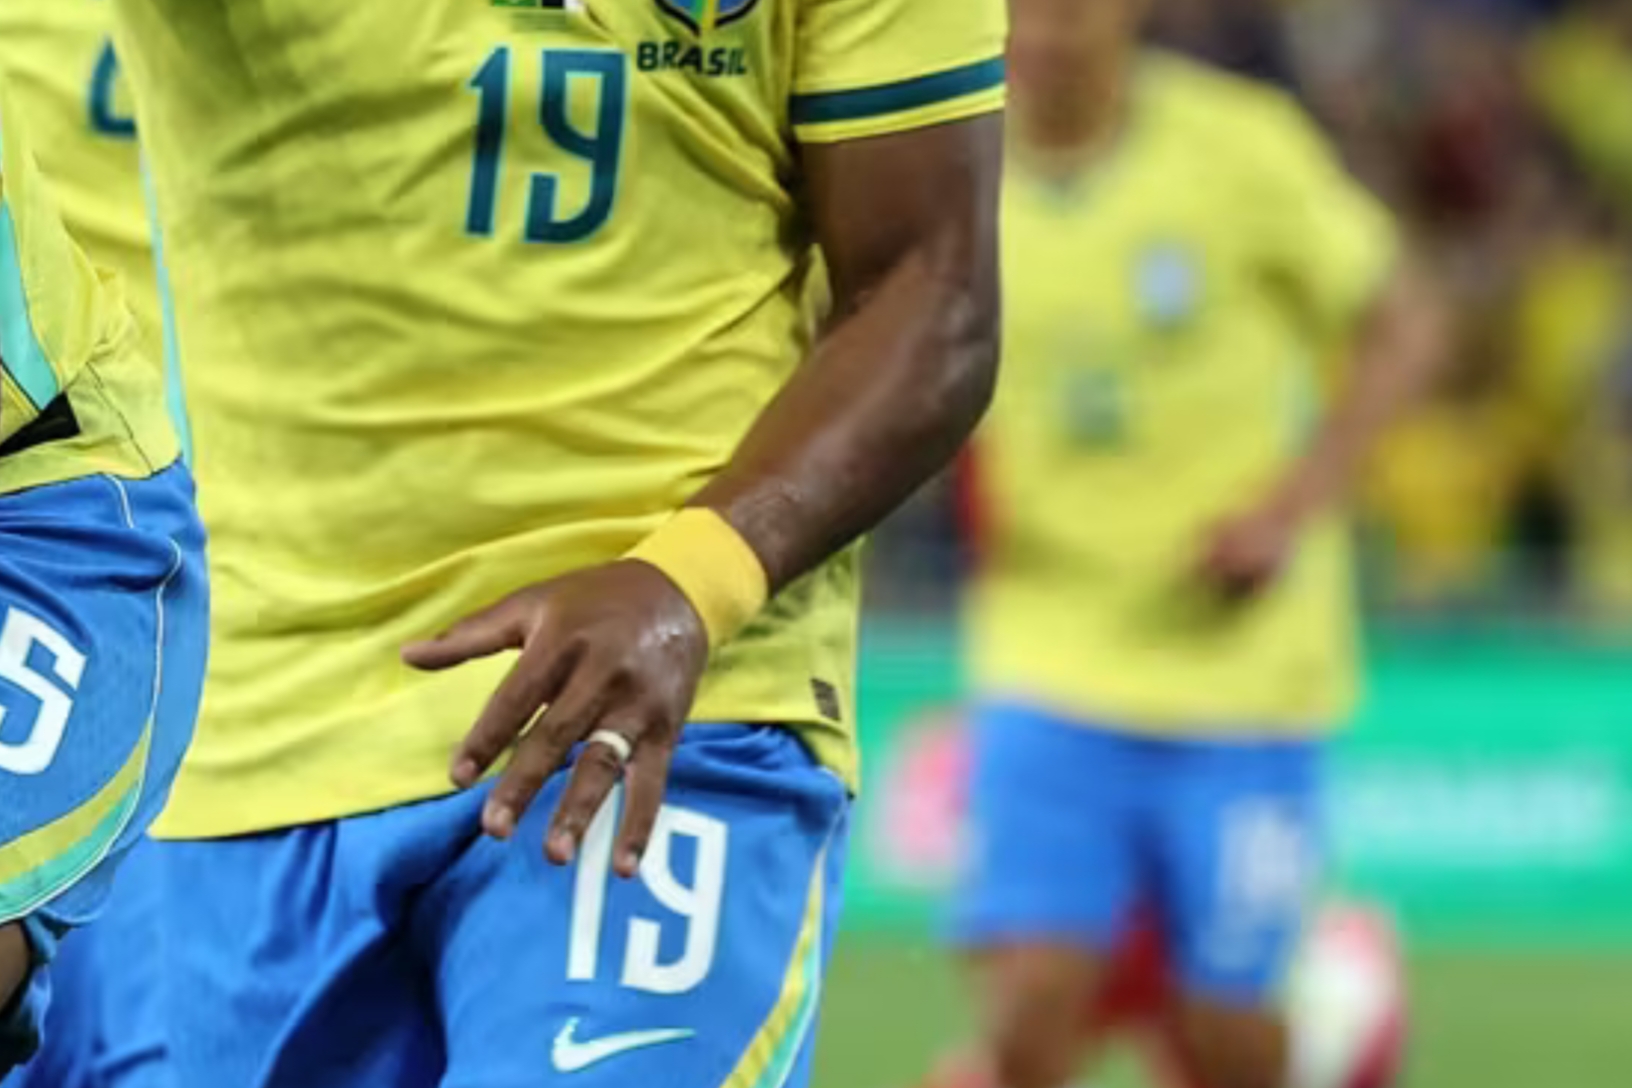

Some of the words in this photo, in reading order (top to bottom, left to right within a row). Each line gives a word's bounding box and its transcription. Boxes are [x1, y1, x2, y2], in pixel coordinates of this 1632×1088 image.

[463, 44, 629, 245] 19
[636, 41, 747, 78] BRASIL
[567, 783, 729, 995] 19
